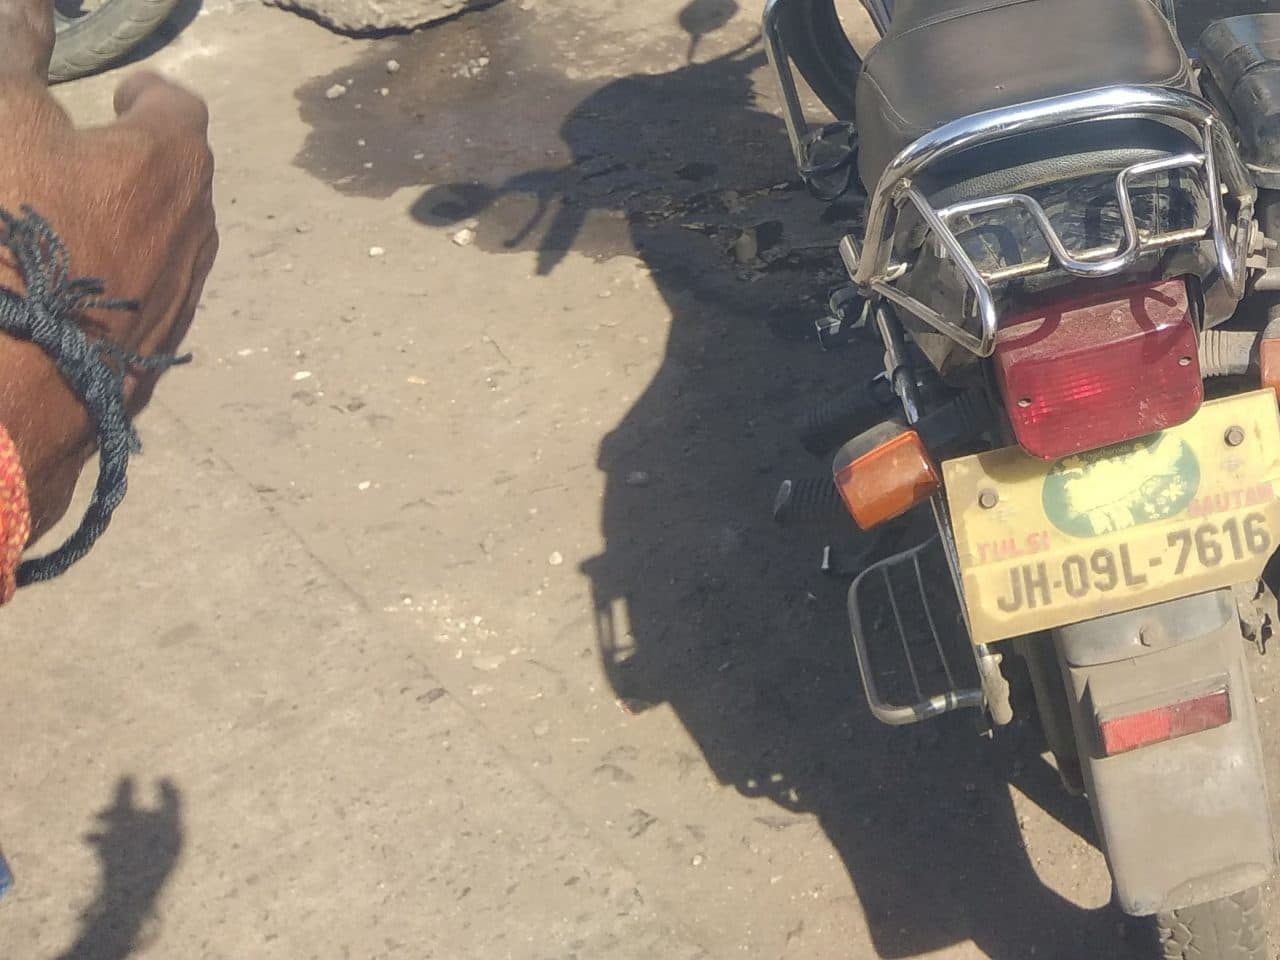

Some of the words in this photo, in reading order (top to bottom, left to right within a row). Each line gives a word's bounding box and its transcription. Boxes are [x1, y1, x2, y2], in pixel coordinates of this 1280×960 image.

[1186, 482, 1275, 519] GAUTAM
[977, 530, 1051, 565] TULSI
[997, 511, 1271, 614] JH-09L-7616
